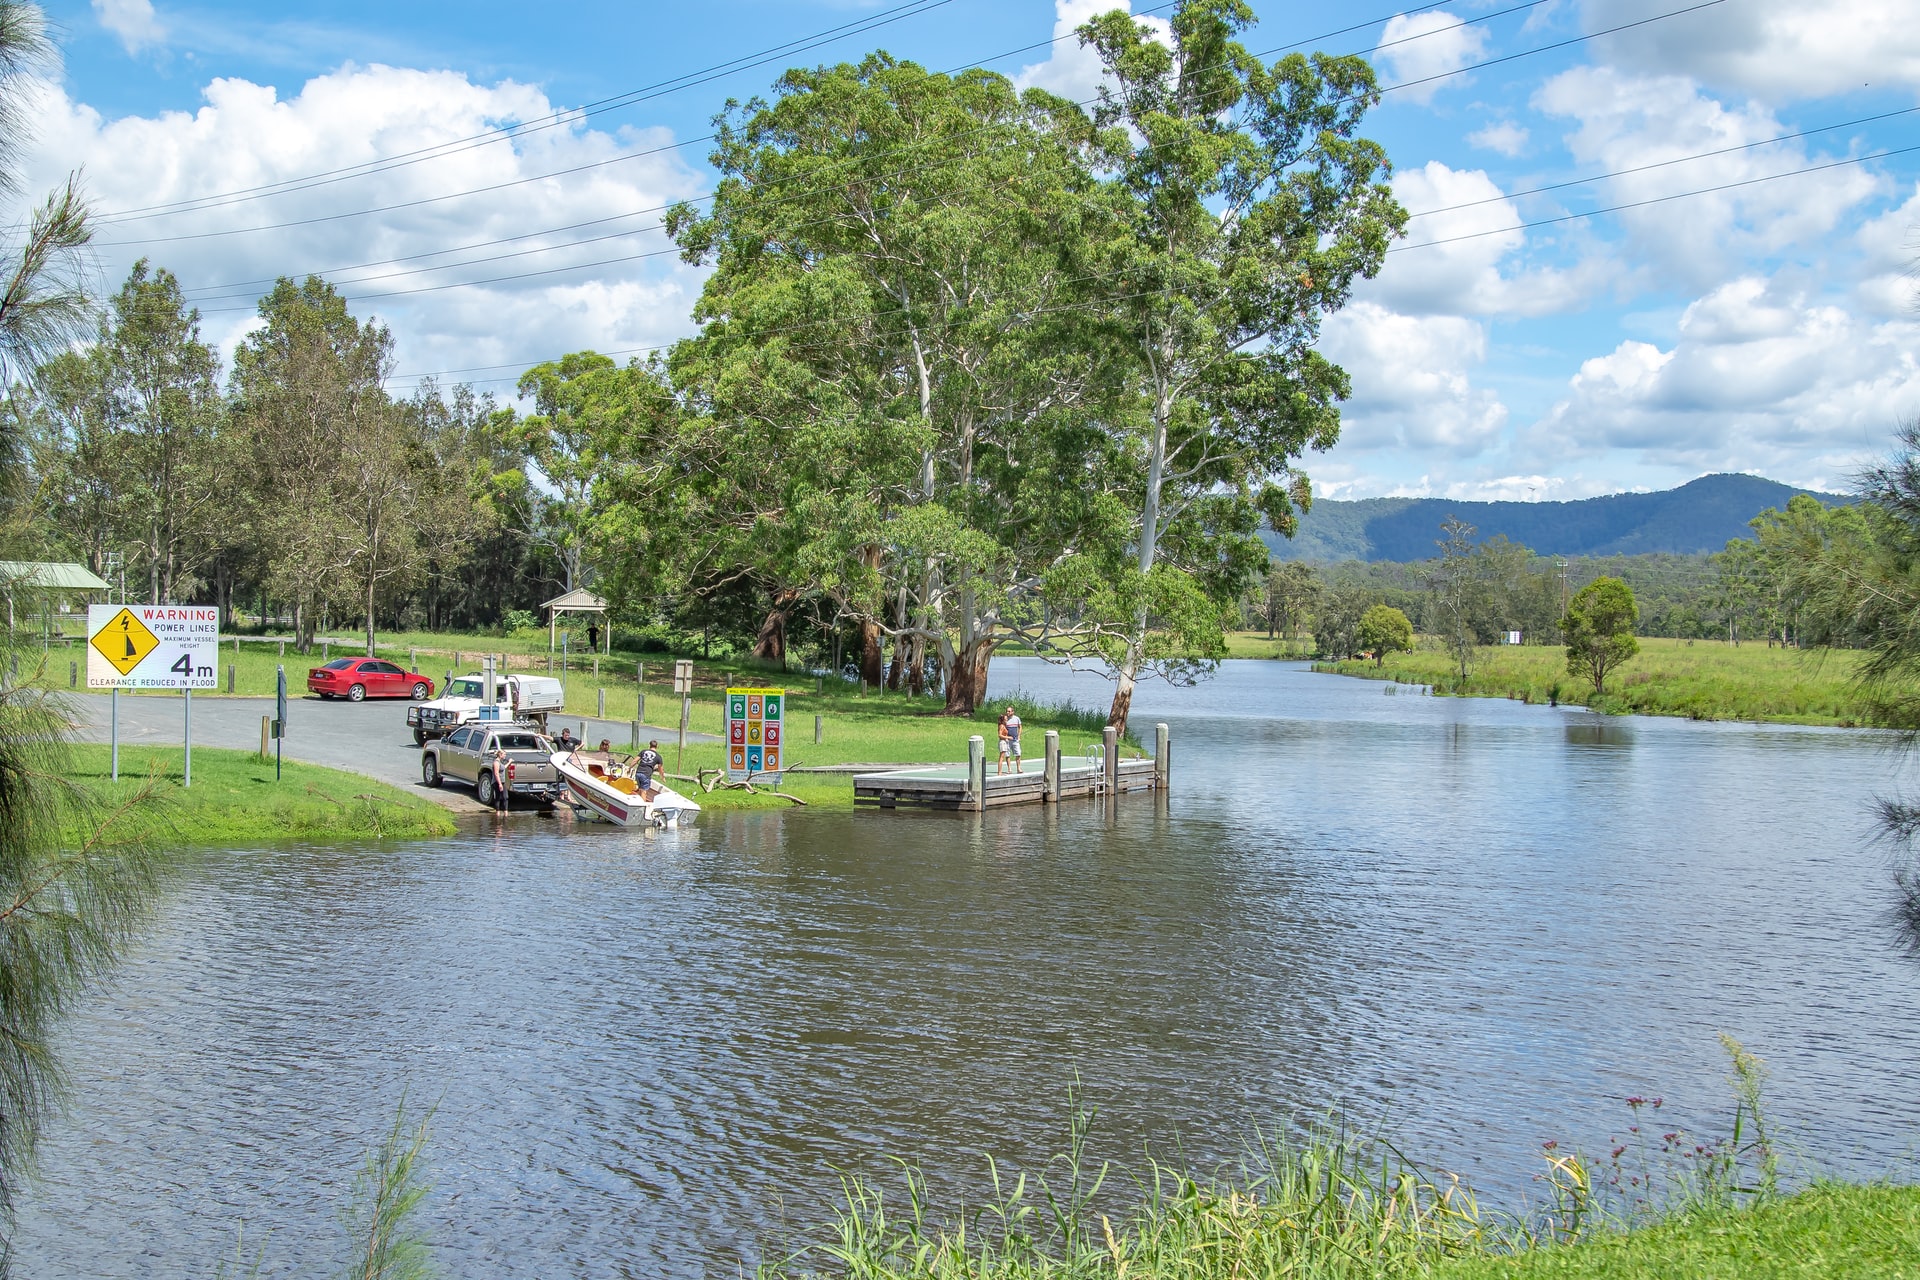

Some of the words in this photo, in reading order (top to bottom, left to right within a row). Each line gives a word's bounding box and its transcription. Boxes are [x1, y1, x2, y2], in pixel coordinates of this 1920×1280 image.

[144, 610, 216, 620] WARNING
[171, 654, 193, 677] 4
[198, 666, 212, 677] m
